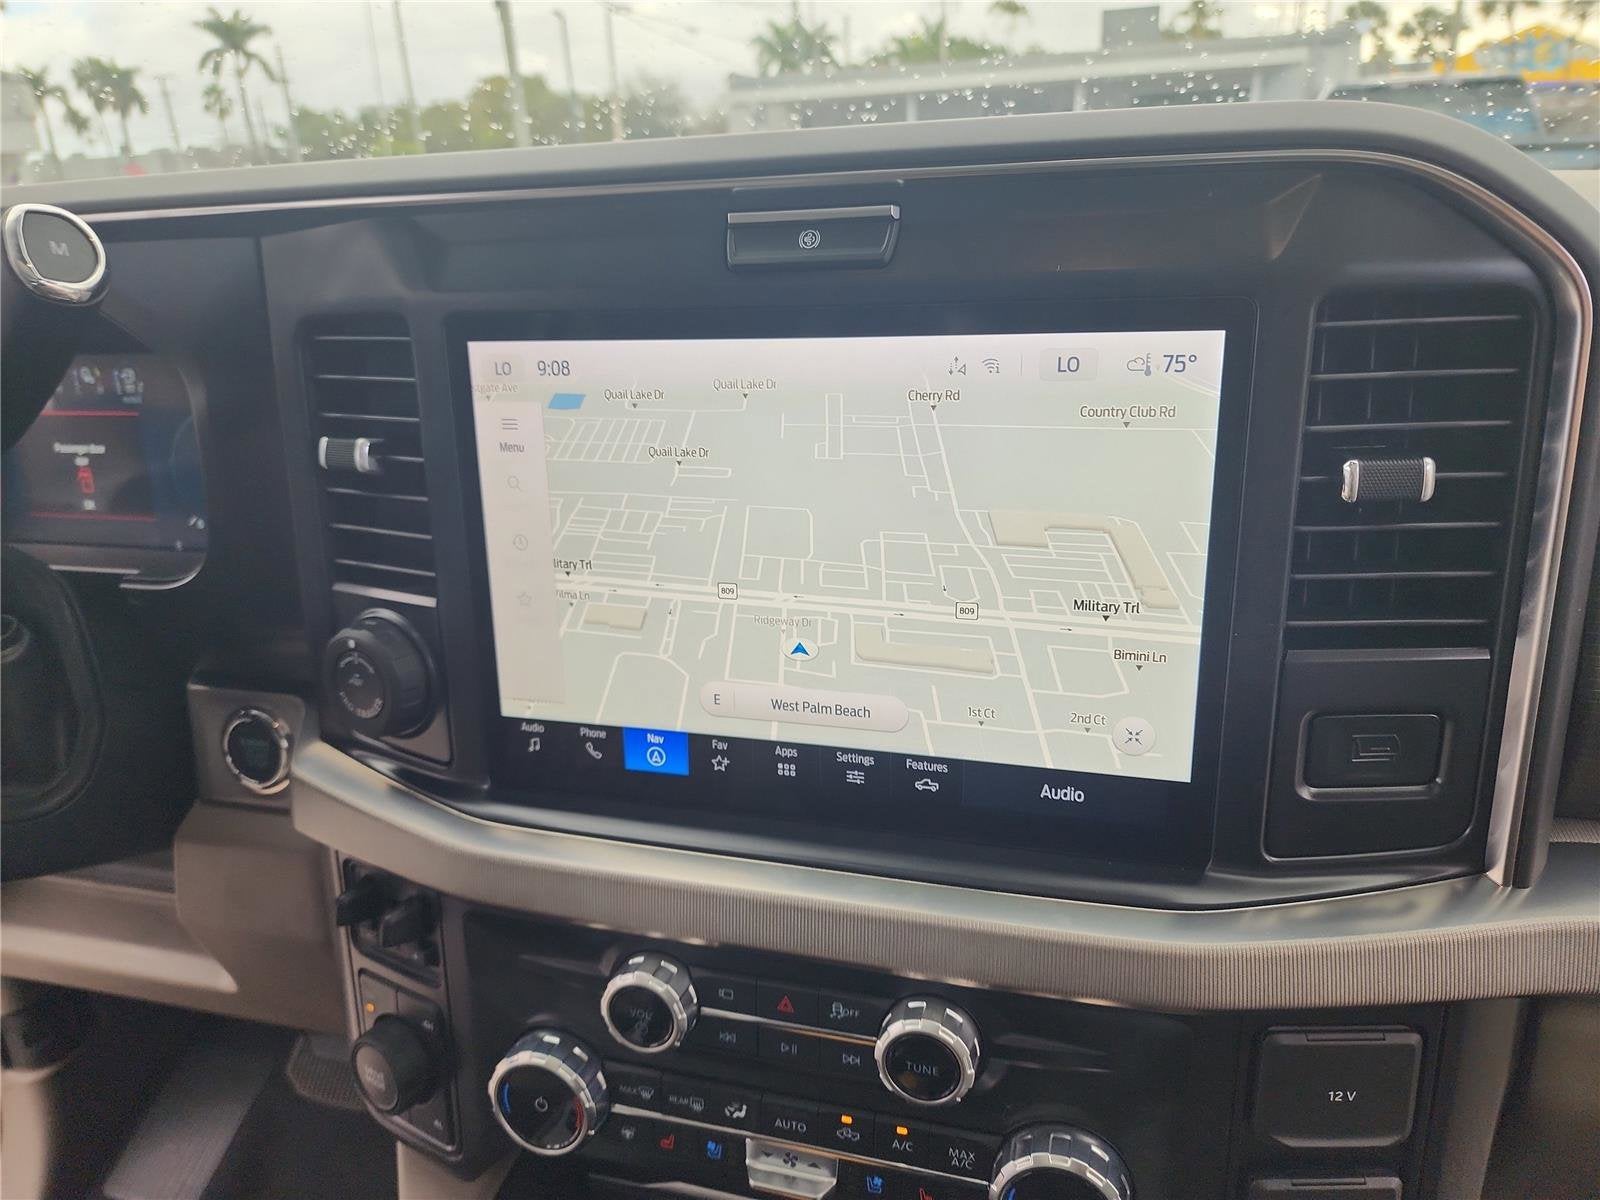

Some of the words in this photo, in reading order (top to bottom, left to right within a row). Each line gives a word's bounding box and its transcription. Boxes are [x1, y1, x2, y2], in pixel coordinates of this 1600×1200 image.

[494, 361, 512, 376] LO
[537, 360, 570, 376] 9:08
[1057, 356, 1080, 372] LO
[1163, 354, 1197, 373] 75°
[713, 378, 738, 391] Quail
[740, 379, 764, 390] Lake
[766, 380, 777, 390] Dr
[604, 389, 629, 402] Quail
[630, 390, 653, 401] Lake
[655, 390, 665, 401] Dr
[908, 389, 942, 404] Cherry
[944, 390, 960, 401] Rd
[1080, 405, 1127, 420] Country
[1129, 406, 1156, 418] Club
[1158, 406, 1176, 418] Rd
[500, 442, 525, 453] Menu
[648, 446, 672, 458] Quail
[674, 447, 697, 458] Lake
[699, 447, 709, 458] Dr
[579, 560, 592, 570] Trl
[720, 586, 735, 596] 809
[959, 607, 975, 617] 809
[1073, 600, 1120, 615] Military
[1123, 602, 1140, 614] Trl
[754, 615, 800, 627] Ridgeway
[802, 617, 812, 627] Dr
[1113, 650, 1149, 662] Bimini
[1151, 651, 1167, 663] Ln
[713, 694, 721, 705] E
[771, 699, 799, 713] West
[802, 701, 832, 715] Palm
[835, 704, 871, 718] Beach
[968, 707, 980, 719] 1st
[982, 708, 996, 719] Ct
[1070, 713, 1090, 725] 2nd
[1092, 714, 1107, 726] Ct
[521, 721, 545, 733] Audio
[580, 727, 607, 739] Phone
[647, 733, 664, 744] Nav
[712, 740, 728, 751] Fav
[775, 746, 798, 759] Apps
[836, 751, 875, 766] Settings
[906, 759, 948, 773] Features
[1040, 784, 1084, 802] Audio
[906, 1061, 940, 1076] TUNE
[1328, 1090, 1343, 1102] 12
[1347, 1090, 1356, 1102] V
[774, 1117, 807, 1133] AUTO
[892, 1139, 914, 1153] A/C
[949, 1148, 975, 1161] MAX
[951, 1157, 974, 1170] A/C
